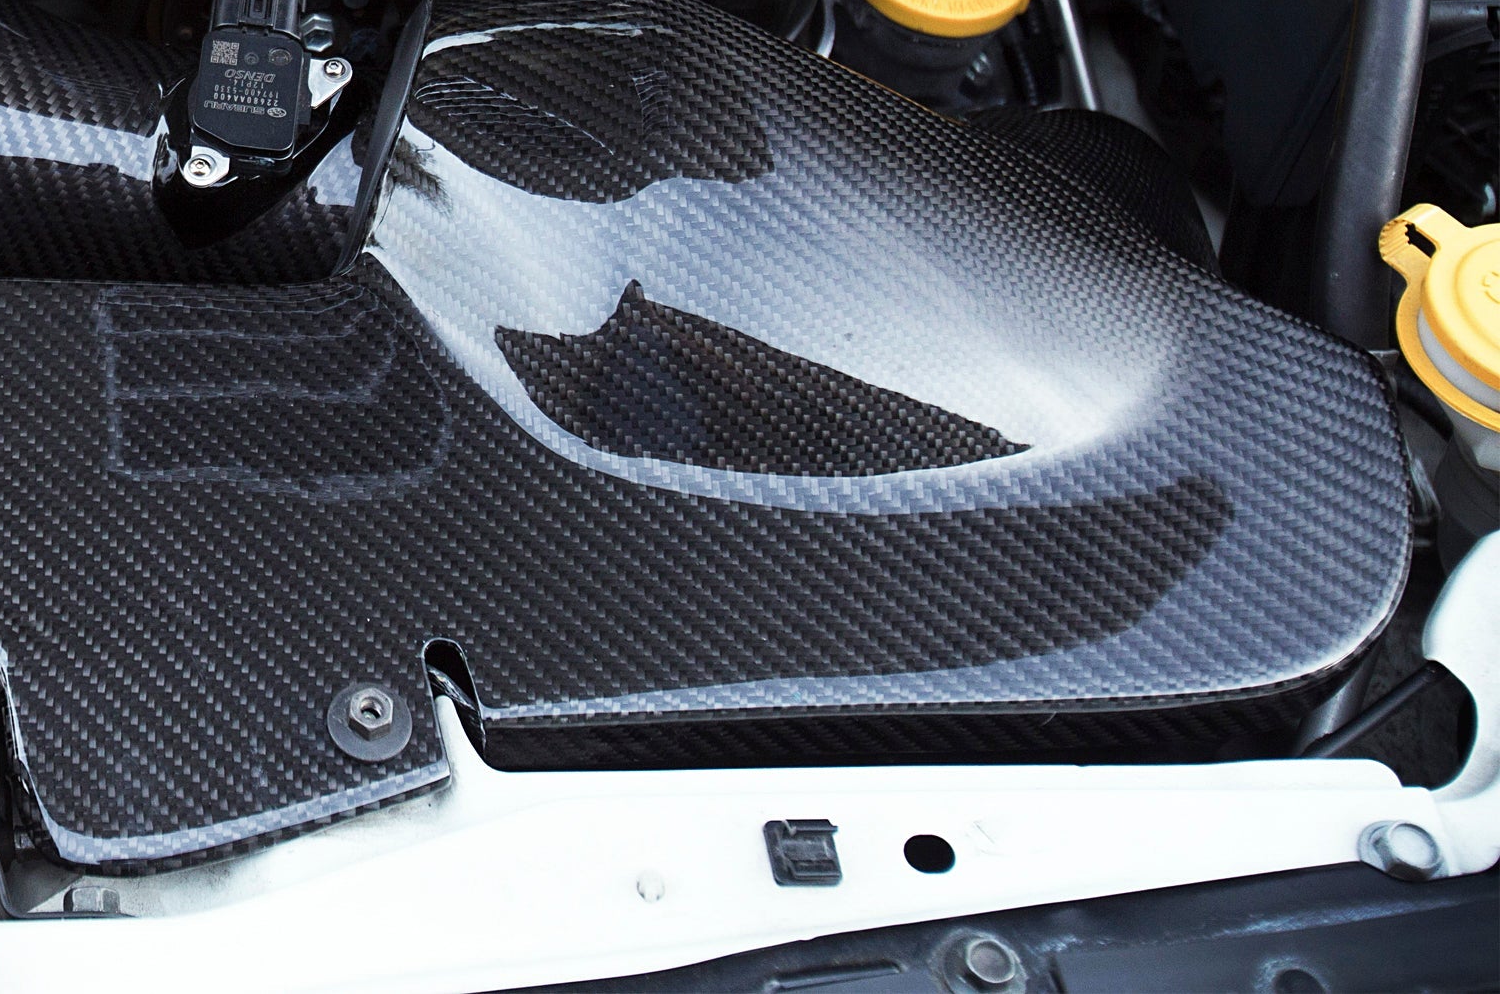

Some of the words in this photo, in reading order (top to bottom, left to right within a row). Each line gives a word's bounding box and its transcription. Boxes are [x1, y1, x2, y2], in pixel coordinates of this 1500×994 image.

[225, 68, 276, 83] DENSO
[204, 100, 266, 116] SUBARU
[213, 92, 279, 108] 22680AA400
